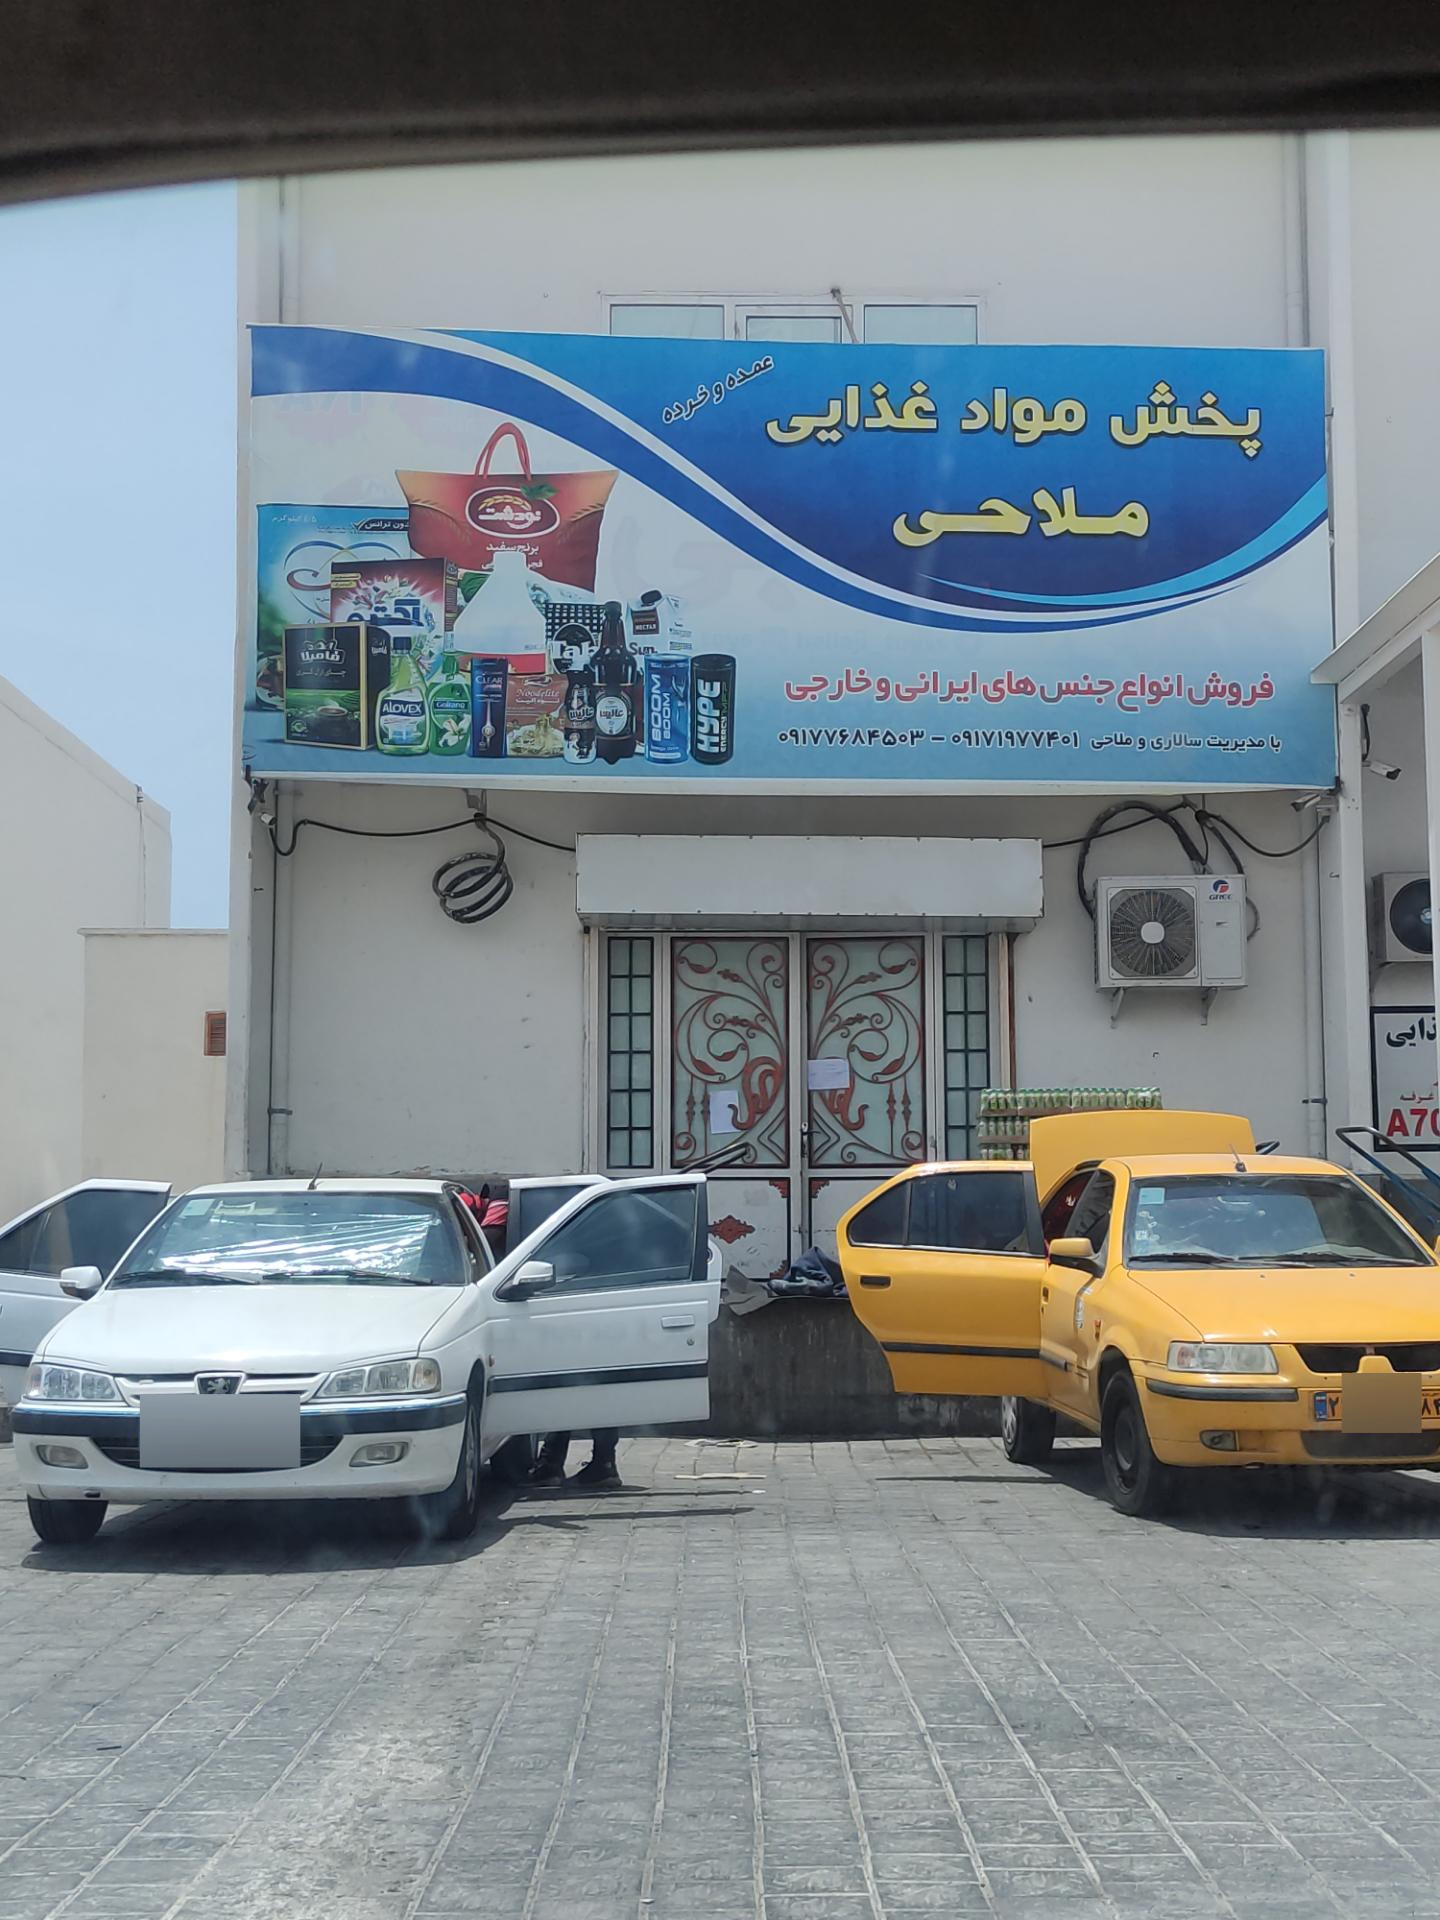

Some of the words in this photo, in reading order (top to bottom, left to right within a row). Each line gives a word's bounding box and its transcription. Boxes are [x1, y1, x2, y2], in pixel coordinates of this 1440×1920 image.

[726, 355, 774, 390] عمده
[662, 385, 710, 424] خرده
[713, 381, 724, 404] و
[765, 380, 939, 445] غذایی
[960, 387, 1086, 446] مواد
[1109, 380, 1264, 458] پخش
[392, 520, 410, 531] دون
[892, 486, 1150, 548] ملاحی
[475, 675, 503, 685] CLEAR
[895, 670, 978, 703] ایرانی
[982, 670, 1037, 703] های
[1039, 673, 1116, 704] جنس
[1117, 672, 1183, 712] انواع
[1186, 671, 1274, 707] فروش
[383, 702, 422, 716] ALOVEX
[651, 674, 662, 742] BOOM
[663, 693, 671, 739] BOOM
[697, 678, 721, 753] HYPE
[778, 727, 926, 747] ۰۹۱۷۷۶۸۴۵۰۳
[951, 728, 1080, 748] ۰۹۱۷۱۹۷۷۴۰۱
[1091, 732, 1133, 751] ملاحی
[1137, 737, 1147, 750] و
[1150, 733, 1202, 750] سالاری
[1206, 734, 1265, 752] مدیریت
[1269, 734, 1282, 753] با
[1386, 1017, 1436, 1047] ذایی
